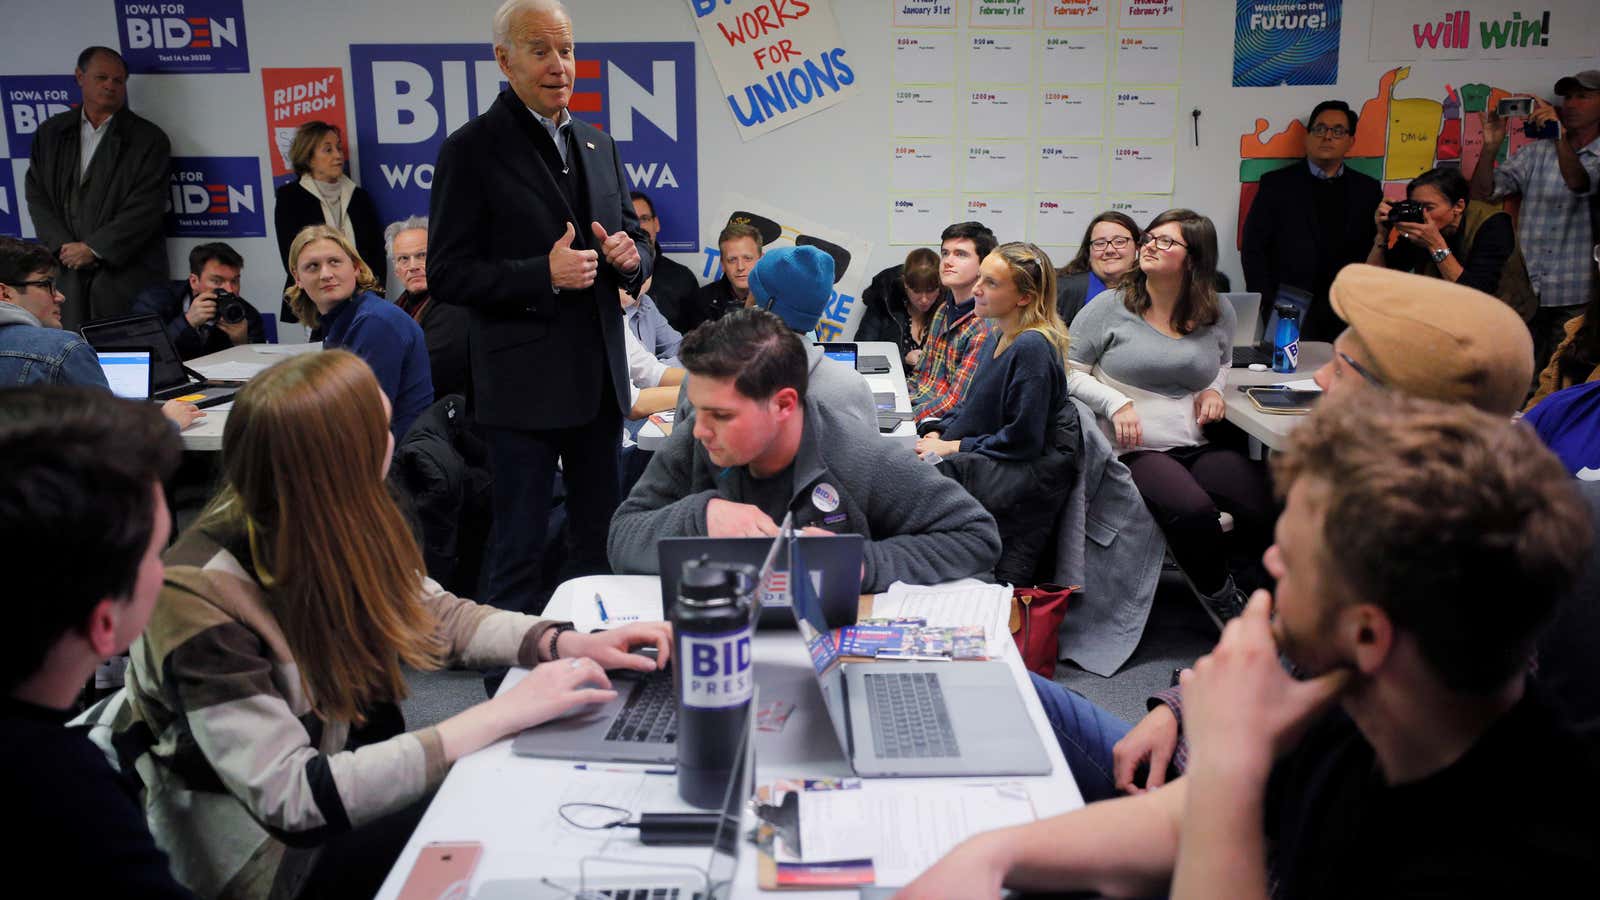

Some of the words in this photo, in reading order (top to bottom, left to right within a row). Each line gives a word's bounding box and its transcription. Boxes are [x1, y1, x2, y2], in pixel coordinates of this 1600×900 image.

[125, 5, 159, 14] IOWA
[160, 4, 185, 14] FOR
[902, 5, 931, 15] January
[933, 5, 951, 14] 31st
[979, 6, 1010, 16] February
[1012, 6, 1025, 15] 1st
[1053, 6, 1084, 16] February
[1129, 6, 1161, 16] February
[1254, 4, 1296, 12] Welcome
[1308, 2, 1325, 10] the
[717, 0, 810, 47] WORKS
[1250, 11, 1327, 30] Future!
[1413, 10, 1470, 49] will
[1480, 11, 1551, 49] win!
[126, 17, 239, 49] BIDEN
[753, 39, 802, 70] FOR
[10, 90, 42, 101] IOWA
[44, 90, 69, 100] FOR
[727, 47, 855, 128] UNIONS
[274, 105, 291, 121] IN
[294, 94, 337, 117] FROM
[180, 171, 204, 182] FOR
[163, 184, 255, 214] IDEN
[692, 636, 750, 677] BID
